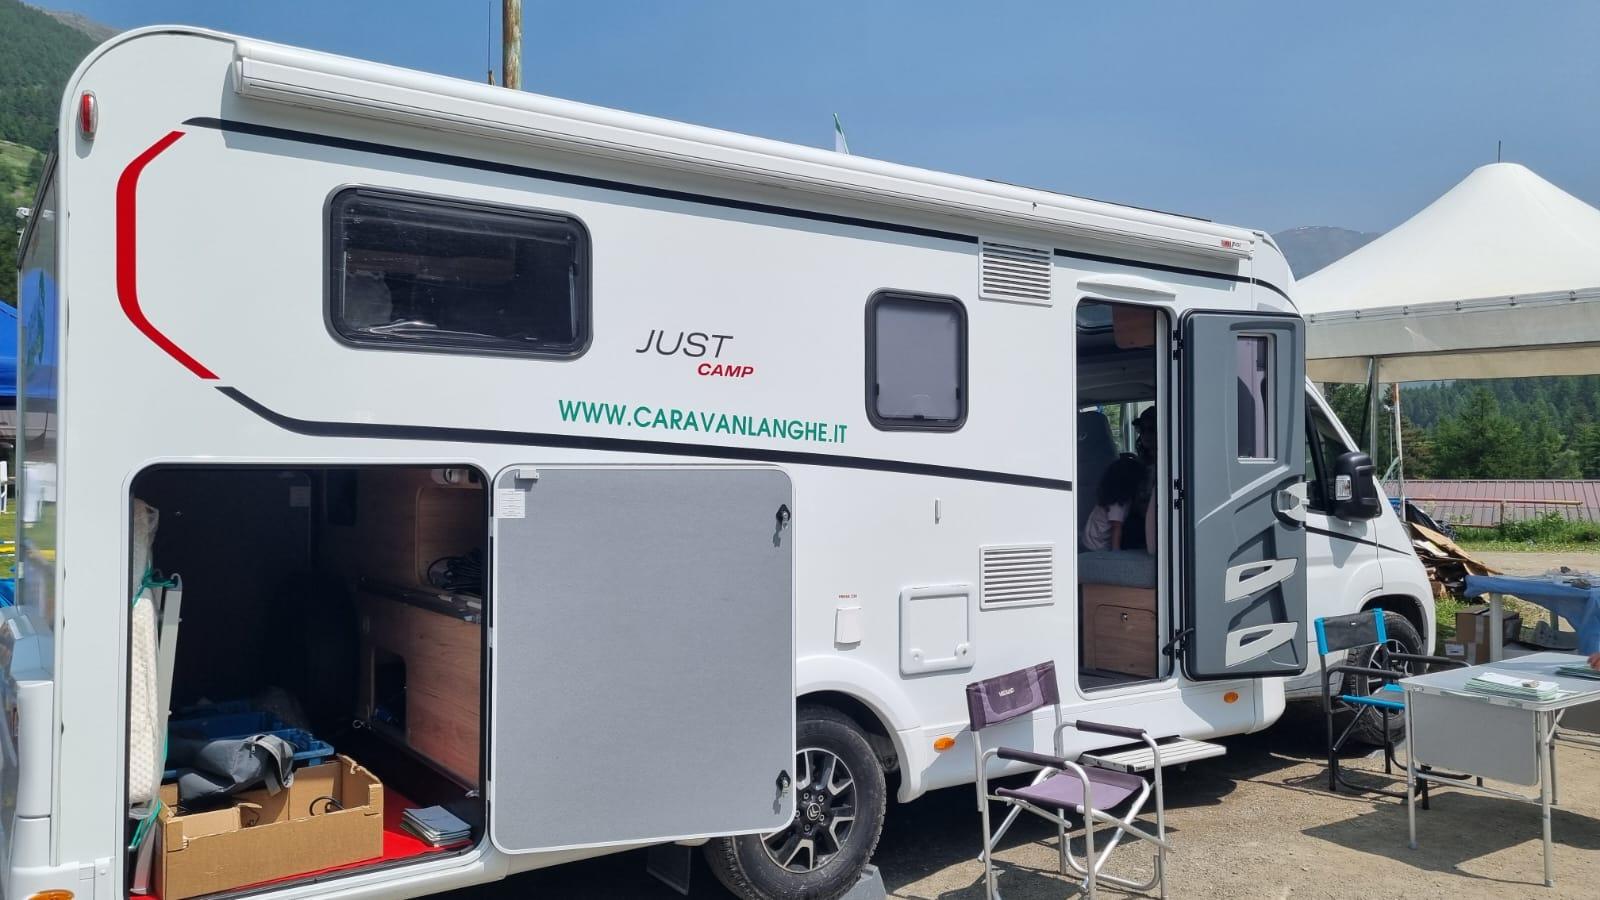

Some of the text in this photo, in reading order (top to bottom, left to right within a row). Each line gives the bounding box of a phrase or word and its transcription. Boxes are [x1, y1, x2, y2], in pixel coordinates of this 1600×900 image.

[636, 330, 734, 358] JUST
[698, 363, 753, 378] CAMP
[559, 400, 847, 442] WWW.CARAVANLANGHE.IT
